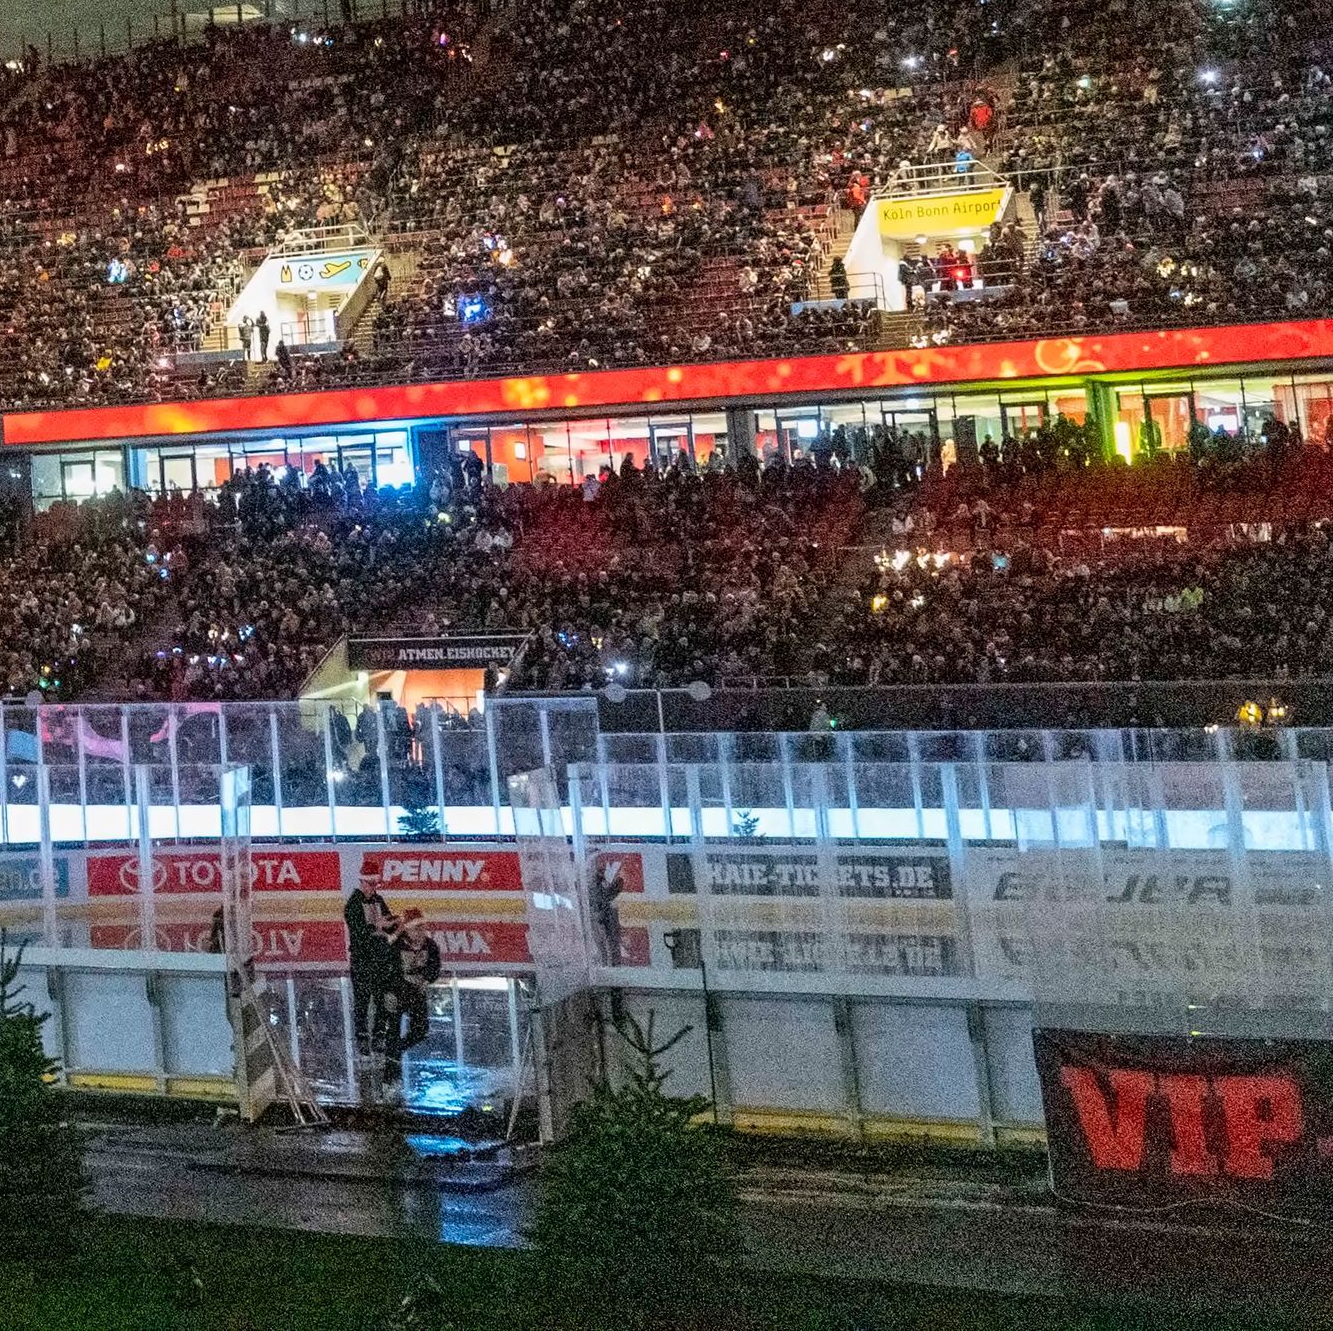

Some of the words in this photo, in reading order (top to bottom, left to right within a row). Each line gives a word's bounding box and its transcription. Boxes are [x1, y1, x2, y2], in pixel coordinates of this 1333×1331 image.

[917, 206, 949, 218] Bonn
[173, 859, 302, 886] TOTA
[383, 859, 485, 883] PENNY
[706, 862, 934, 889] HAIE-TICETS.DE
[1061, 1065, 1304, 1180] VIP
